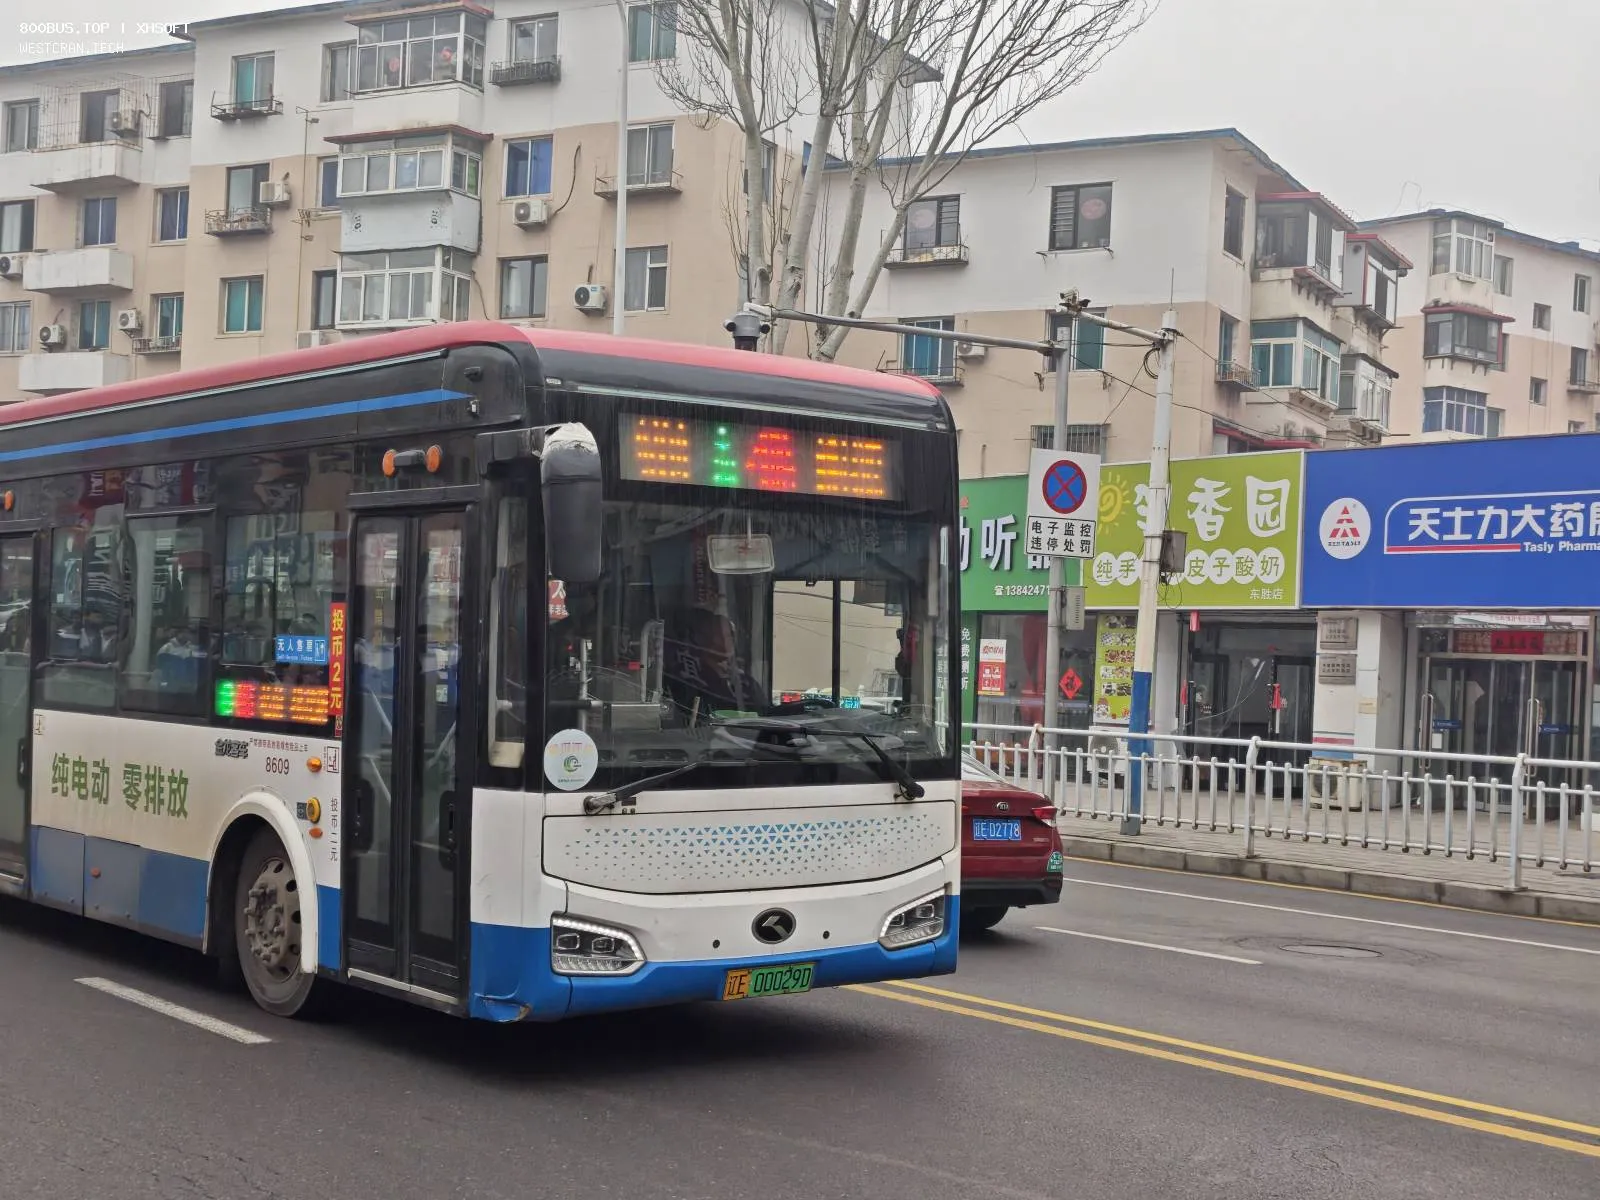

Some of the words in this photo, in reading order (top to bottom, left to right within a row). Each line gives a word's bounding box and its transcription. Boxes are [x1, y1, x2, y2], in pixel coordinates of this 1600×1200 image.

[1031, 520, 1092, 538] 电子监控
[1031, 536, 1092, 554] 违停处罚
[1523, 541, 1554, 553] Tasly
[1096, 554, 1280, 580] 纯手皮子酸奶
[1006, 585, 1050, 596] 13842471
[330, 609, 344, 708] 投币2元
[265, 756, 290, 775] 8609
[51, 752, 109, 804] 纯电动
[122, 763, 189, 818] 零排放
